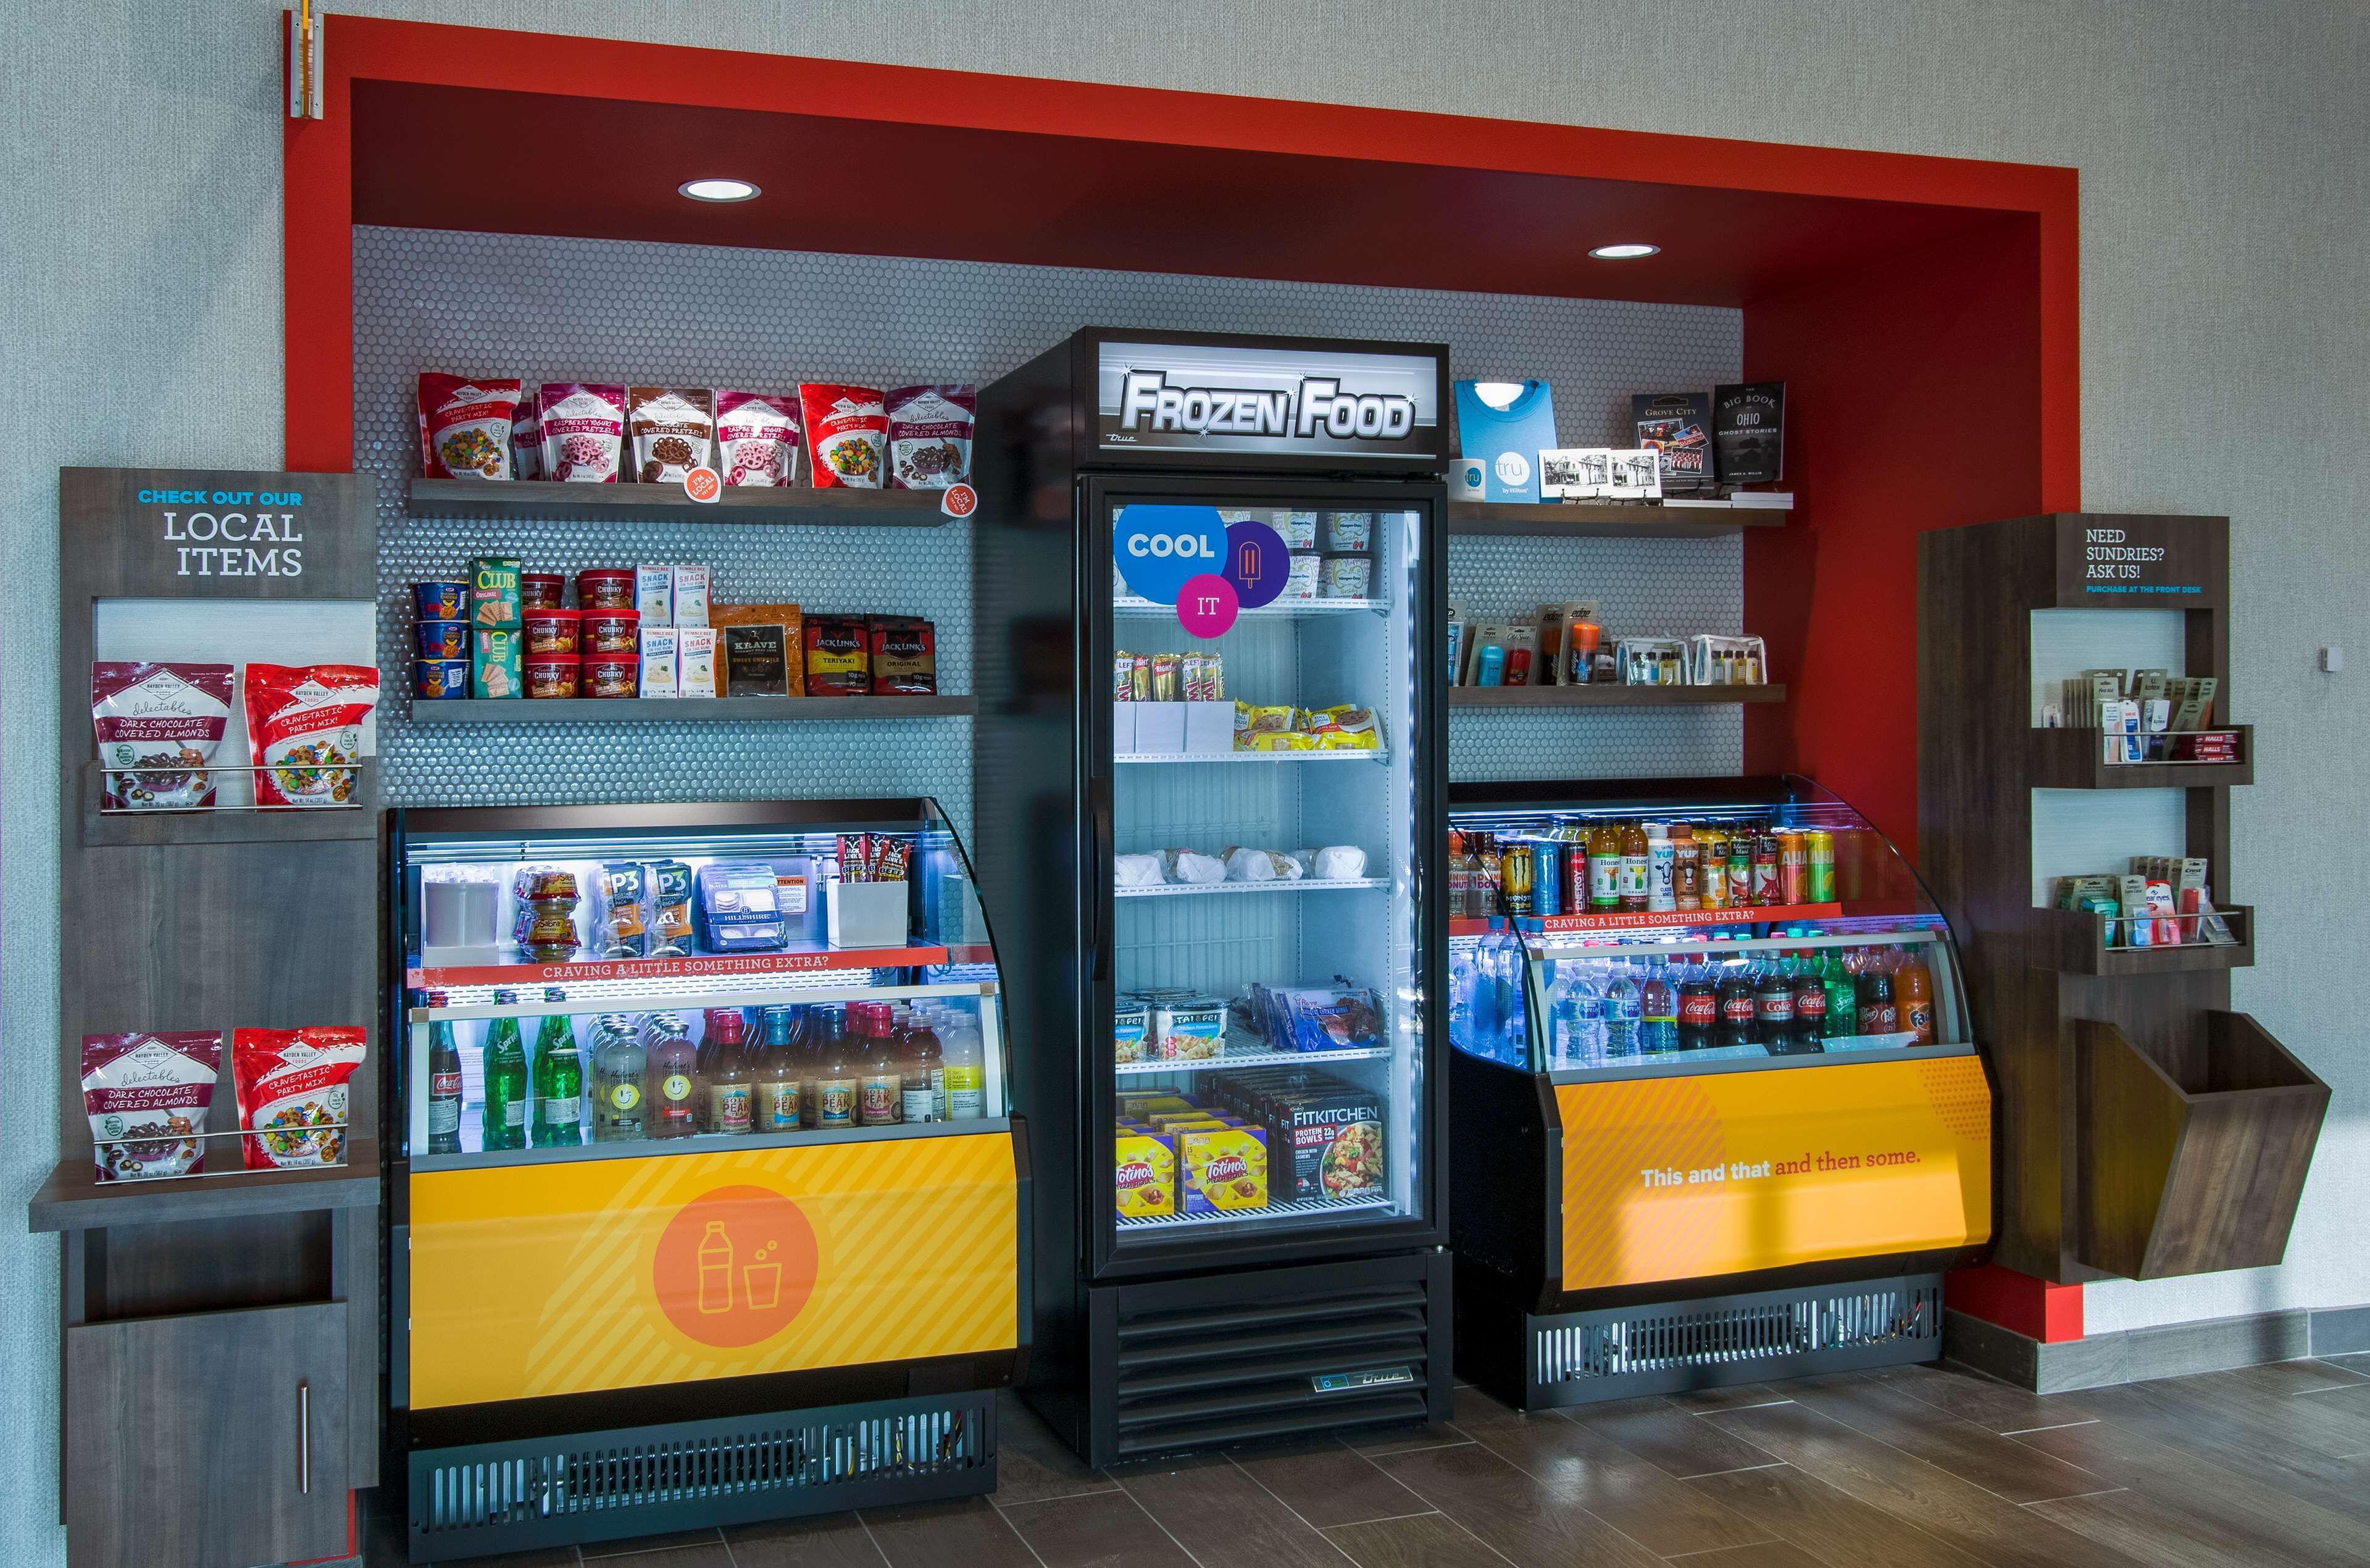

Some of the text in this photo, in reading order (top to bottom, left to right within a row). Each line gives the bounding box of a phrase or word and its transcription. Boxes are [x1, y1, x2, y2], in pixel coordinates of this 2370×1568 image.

[1122, 370, 1416, 440] FROZEN FOOD
[1724, 395, 1775, 409] BIG BOOK
[451, 414, 471, 423] PARTY
[909, 411, 949, 423] delectables
[1737, 413, 1760, 426] OHIO
[582, 426, 615, 435] PRETZELS
[672, 428, 703, 437] PRETZELS
[922, 422, 958, 430] CHOCOLATE
[1496, 460, 1522, 477] tru
[692, 474, 705, 486] I'M
[1466, 472, 1479, 482] tru
[692, 476, 715, 496] LOCAL
[138, 490, 303, 506] CHECK OUT OUR
[951, 489, 967, 513] LOCAL
[961, 491, 970, 504] I'M
[164, 512, 303, 541] LOCAL
[2086, 529, 2126, 543] NEED
[1128, 533, 1214, 557] COOL
[2086, 547, 2164, 561] SUNDRIES?
[177, 548, 303, 577] ITEMS
[641, 573, 668, 582] SNACK
[679, 573, 705, 582] SNACK
[2086, 564, 2140, 578] ASK US!
[477, 570, 516, 590] CLUB
[1198, 597, 1219, 615] IT
[1544, 612, 1563, 621] edge
[1572, 608, 1591, 618] edge
[491, 631, 507, 662] CLUB
[646, 638, 673, 648] SNACK
[685, 638, 711, 648] SNACK
[735, 641, 777, 649] KRAVE
[816, 639, 837, 647] JACK
[881, 643, 901, 651] JACK
[133, 701, 192, 716] delectables
[280, 706, 343, 727] CRAVE-TASTIC
[120, 719, 205, 728] DARK CHOCOLATE
[288, 717, 338, 734] PARTY MIX!
[115, 728, 210, 738] COVERED ALMONDS
[611, 870, 639, 894] P3
[658, 870, 686, 894] P3
[1574, 870, 1582, 911] ENERGY
[538, 919, 560, 928] Sabra
[1545, 911, 1755, 929] CRAVING A LITTLE SOMETHING EXTRA?
[543, 956, 829, 978] CRAVING A LITTLE SOMETHING EXTRA?
[1766, 1001, 1791, 1012] Coke
[1177, 1015, 1193, 1024] TAI
[122, 1069, 180, 1086] delectables
[269, 1067, 330, 1090] CRAVE-TASTIC
[108, 1085, 194, 1099] DARK CHOCOLATE
[277, 1077, 326, 1096] PARTY MIX!
[104, 1095, 198, 1109] COVERED ALMONDS
[823, 1099, 849, 1107] PEAK
[864, 1095, 890, 1103] PEAK
[723, 1102, 750, 1112] PEAK
[774, 1101, 799, 1111] PEAK
[1294, 1106, 1377, 1126] FITKITCHEN
[1281, 1119, 1289, 1130] FIT
[1295, 1128, 1322, 1137] PROTEIN
[1324, 1128, 1334, 1136] 22g
[1296, 1135, 1322, 1145] BOWLS
[1203, 1158, 1247, 1178] Totino's
[1641, 1150, 1921, 1188] This and that and then some.
[1227, 1172, 1249, 1180] ROLLS
